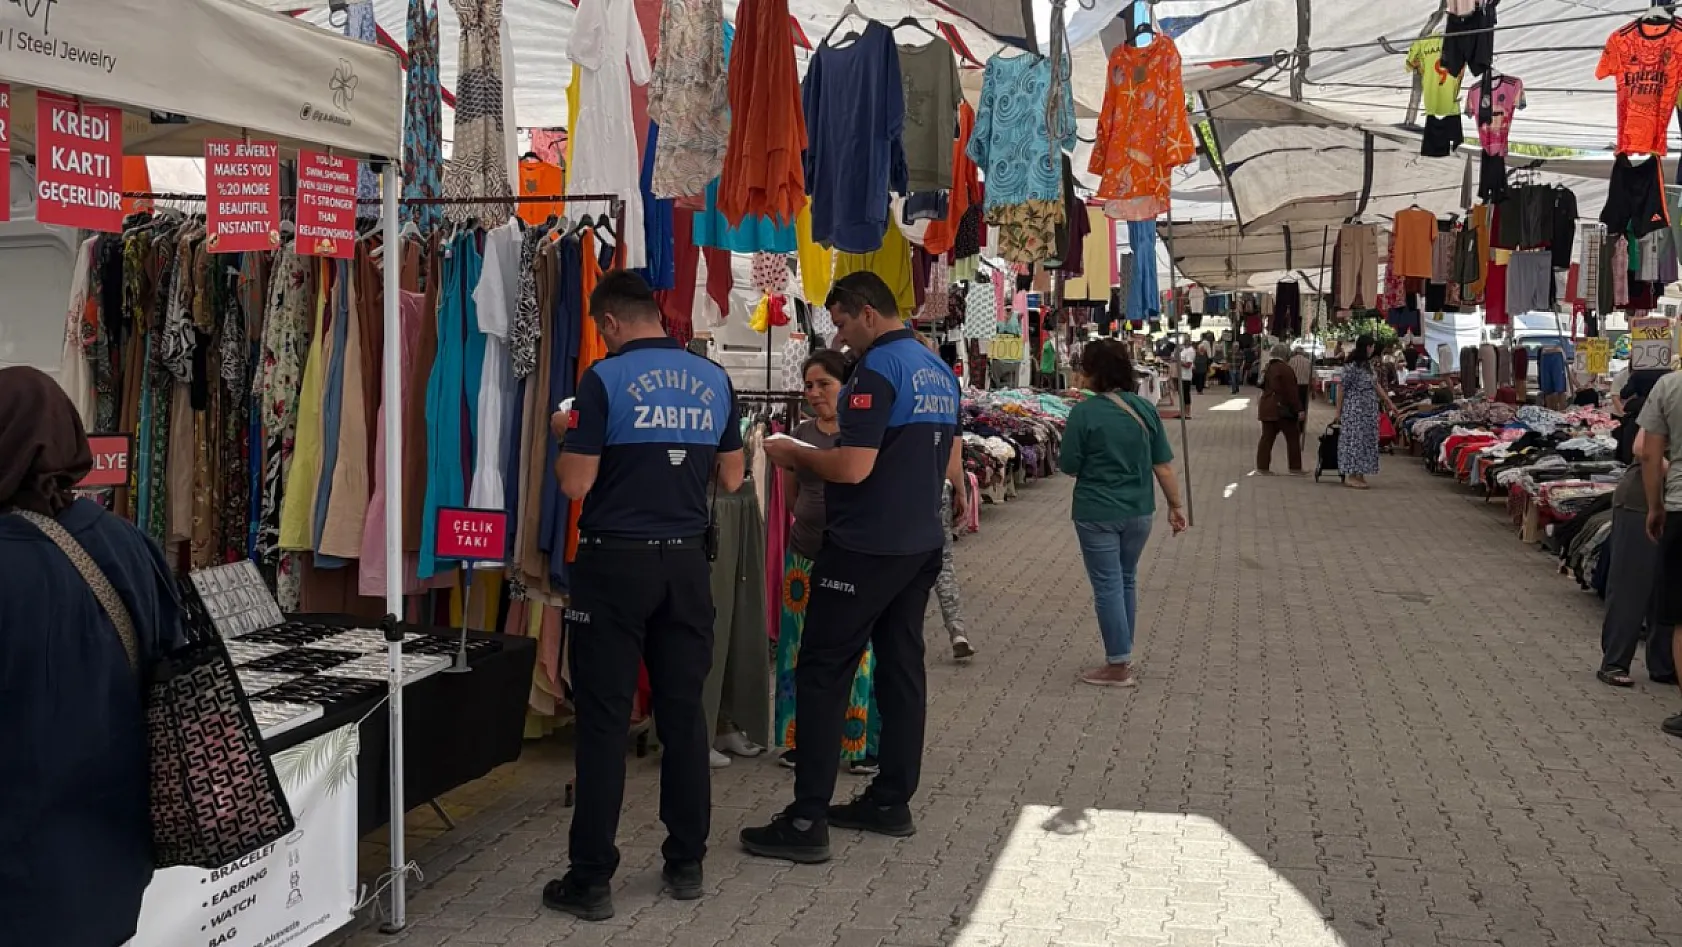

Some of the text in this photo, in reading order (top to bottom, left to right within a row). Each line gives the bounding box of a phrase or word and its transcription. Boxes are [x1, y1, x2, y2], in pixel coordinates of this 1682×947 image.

[17, 31, 57, 57] Steel
[60, 41, 116, 73] Jewelry
[52, 108, 110, 143] KREDİ
[208, 143, 277, 157] THIS JEWERLY
[52, 145, 110, 179] KARTI
[213, 163, 272, 177] MAKES YOU
[38, 180, 123, 211] GEÇERLİDİR
[216, 182, 270, 196] %20 MORE
[219, 202, 269, 215] BEAUTIFUL
[317, 195, 353, 210] STRONGER
[317, 211, 337, 223] THAN
[217, 220, 271, 235] INSTANTLY
[1633, 344, 1671, 367] 250
[626, 368, 715, 406] FETHİYE
[633, 405, 714, 432] ZABITA
[93, 452, 127, 470] LYE
[453, 520, 493, 534] ÇELİK
[456, 535, 488, 548] TAKI
[820, 577, 856, 596] ZABITA
[210, 842, 276, 883] BRACELET
[212, 866, 268, 907] EARRING
[210, 893, 257, 928] WATCH
